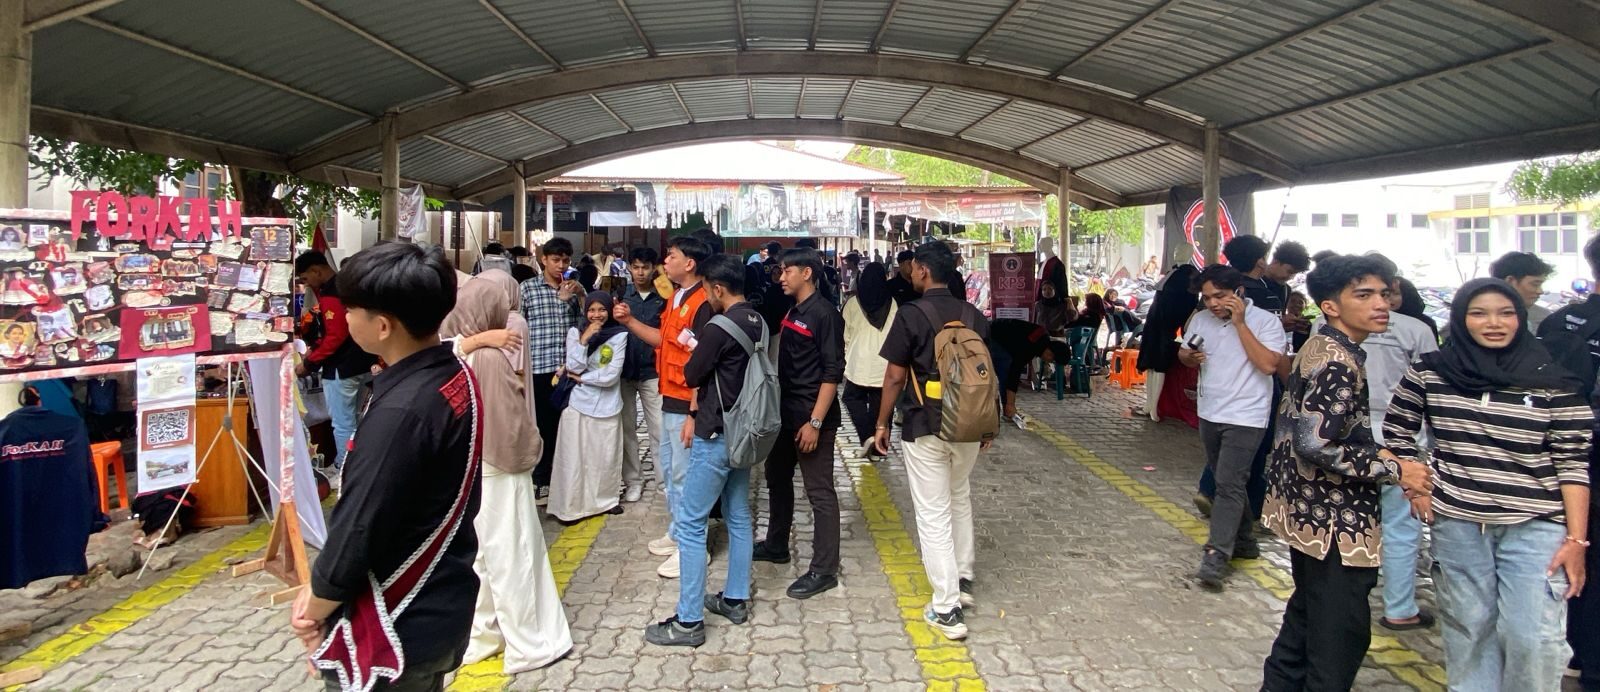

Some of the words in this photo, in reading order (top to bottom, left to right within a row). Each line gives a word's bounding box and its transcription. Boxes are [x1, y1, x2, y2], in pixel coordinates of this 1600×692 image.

[69, 190, 242, 249] FORKAH
[263, 229, 277, 241] 12
[998, 276, 1026, 290] KPS
